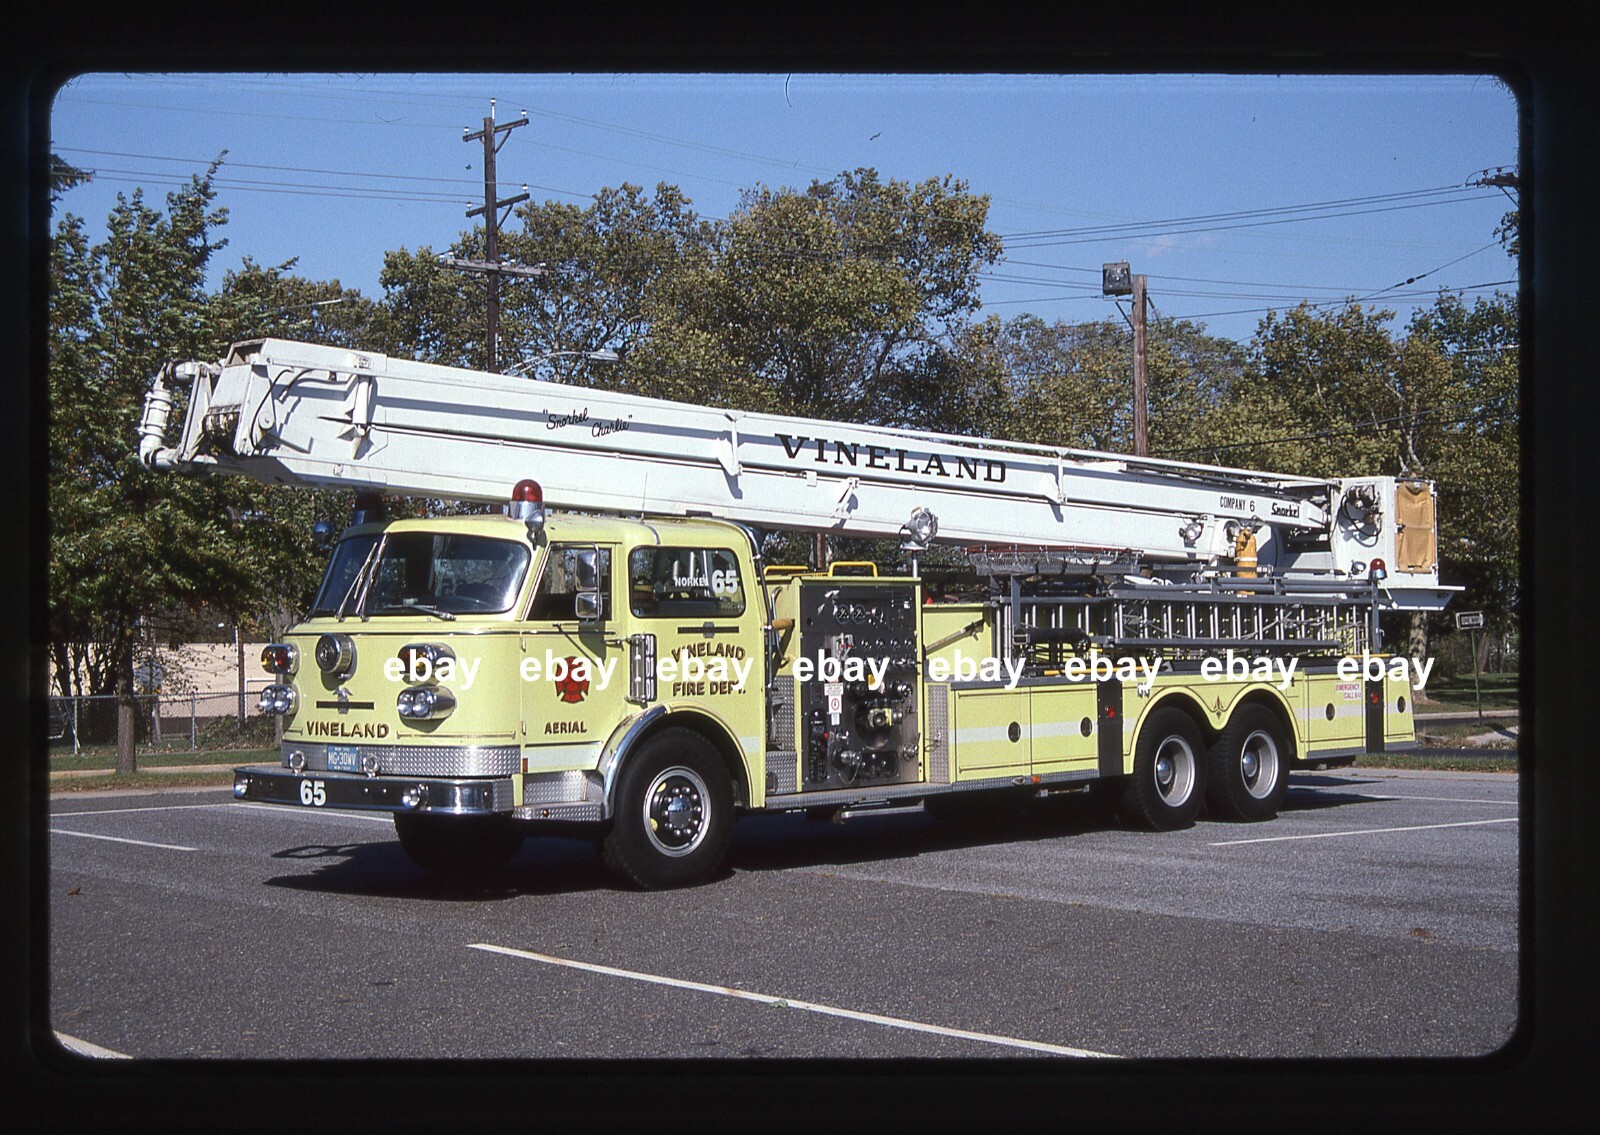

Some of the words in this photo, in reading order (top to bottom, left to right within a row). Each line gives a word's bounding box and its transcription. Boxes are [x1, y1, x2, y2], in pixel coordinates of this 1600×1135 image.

[774, 433, 1006, 483] VINELAND
[1219, 496, 1246, 511] COMPANY
[1249, 500, 1256, 513] 6
[711, 569, 738, 594] 65
[672, 681, 706, 697] FIRE
[306, 721, 390, 738] VINELAND
[544, 721, 588, 734] AERIAL
[300, 779, 326, 807] 65
